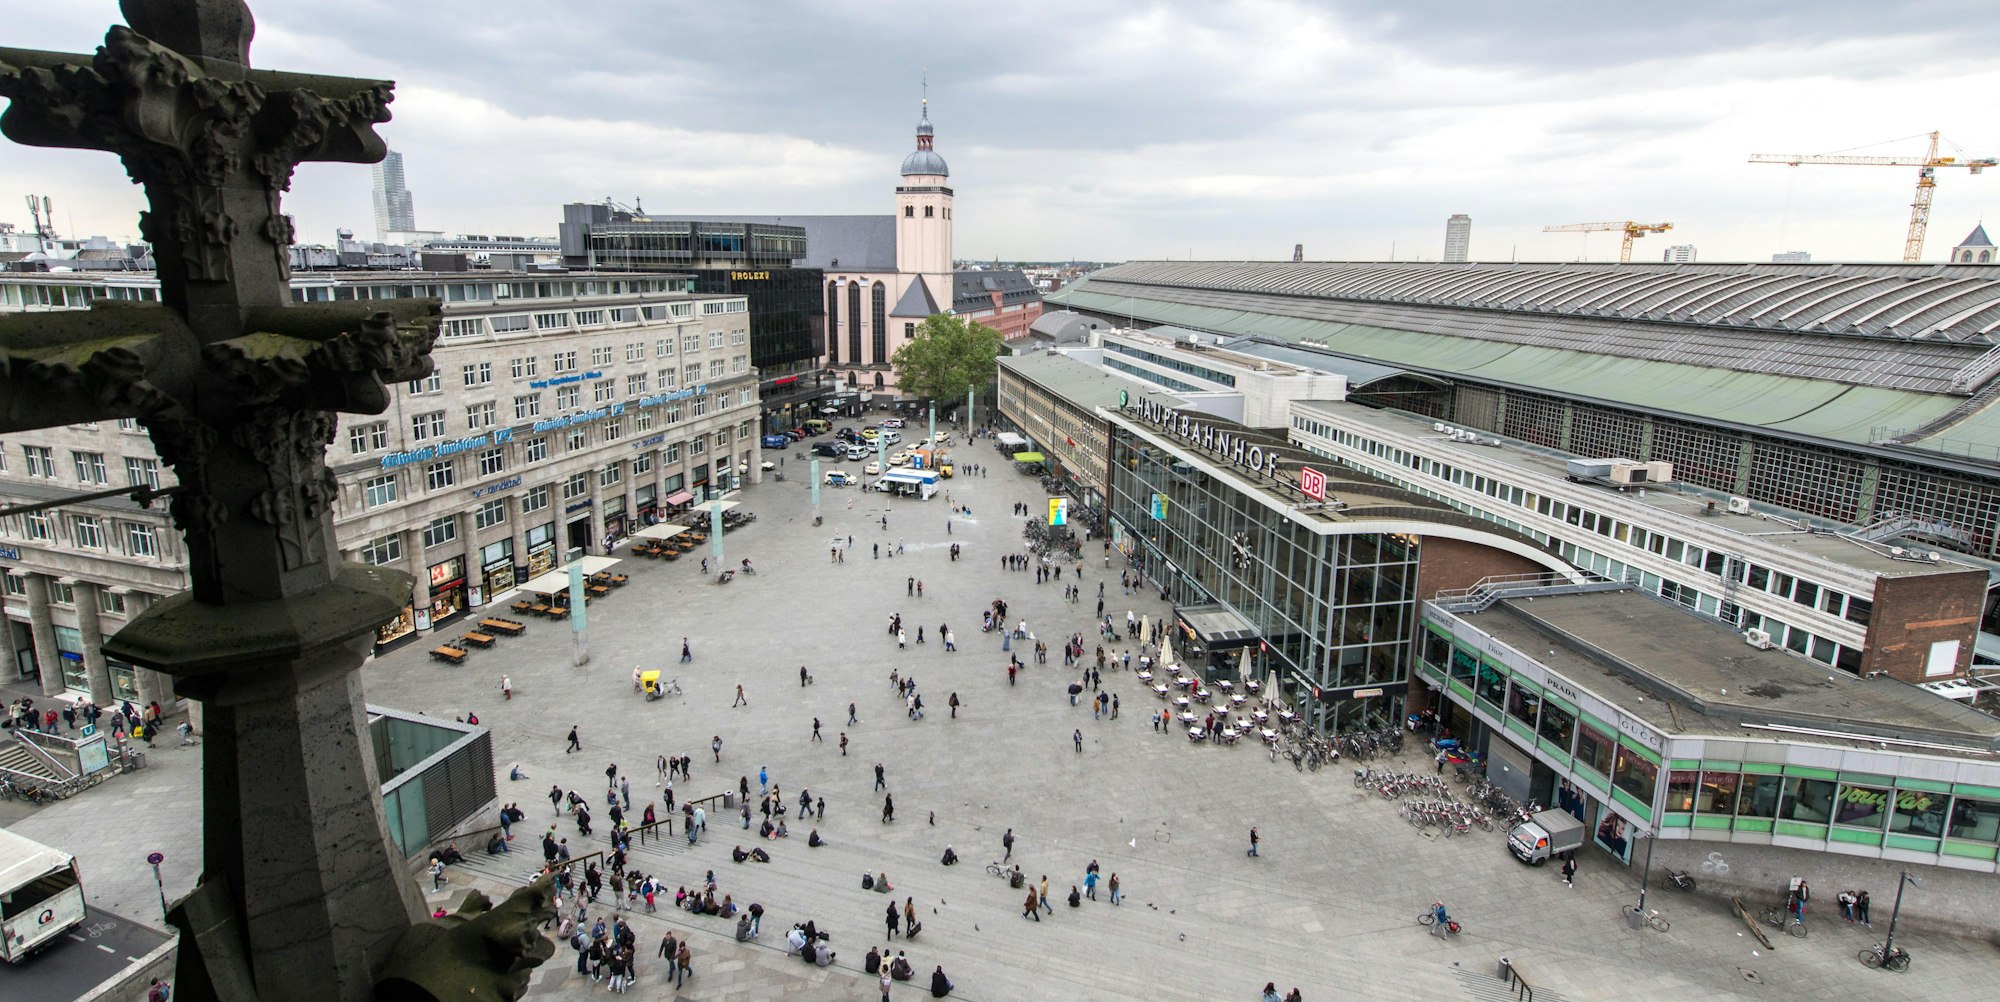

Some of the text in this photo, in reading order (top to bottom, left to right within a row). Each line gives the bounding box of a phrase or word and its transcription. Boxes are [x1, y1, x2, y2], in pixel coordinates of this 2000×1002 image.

[737, 272, 765, 280] ROLEX
[1120, 391, 1127, 406] S
[1136, 396, 1279, 478] HAUPTBAHNHOF
[381, 435, 488, 470] Kölnische Rundschau
[487, 475, 521, 494] randstad
[1303, 472, 1320, 495] DB
[1488, 643, 1503, 657] Dior
[1547, 678, 1577, 700] PRADA
[84, 726, 93, 736] U
[1621, 720, 1663, 749] GUCCI
[1704, 774, 1733, 785] benefit
